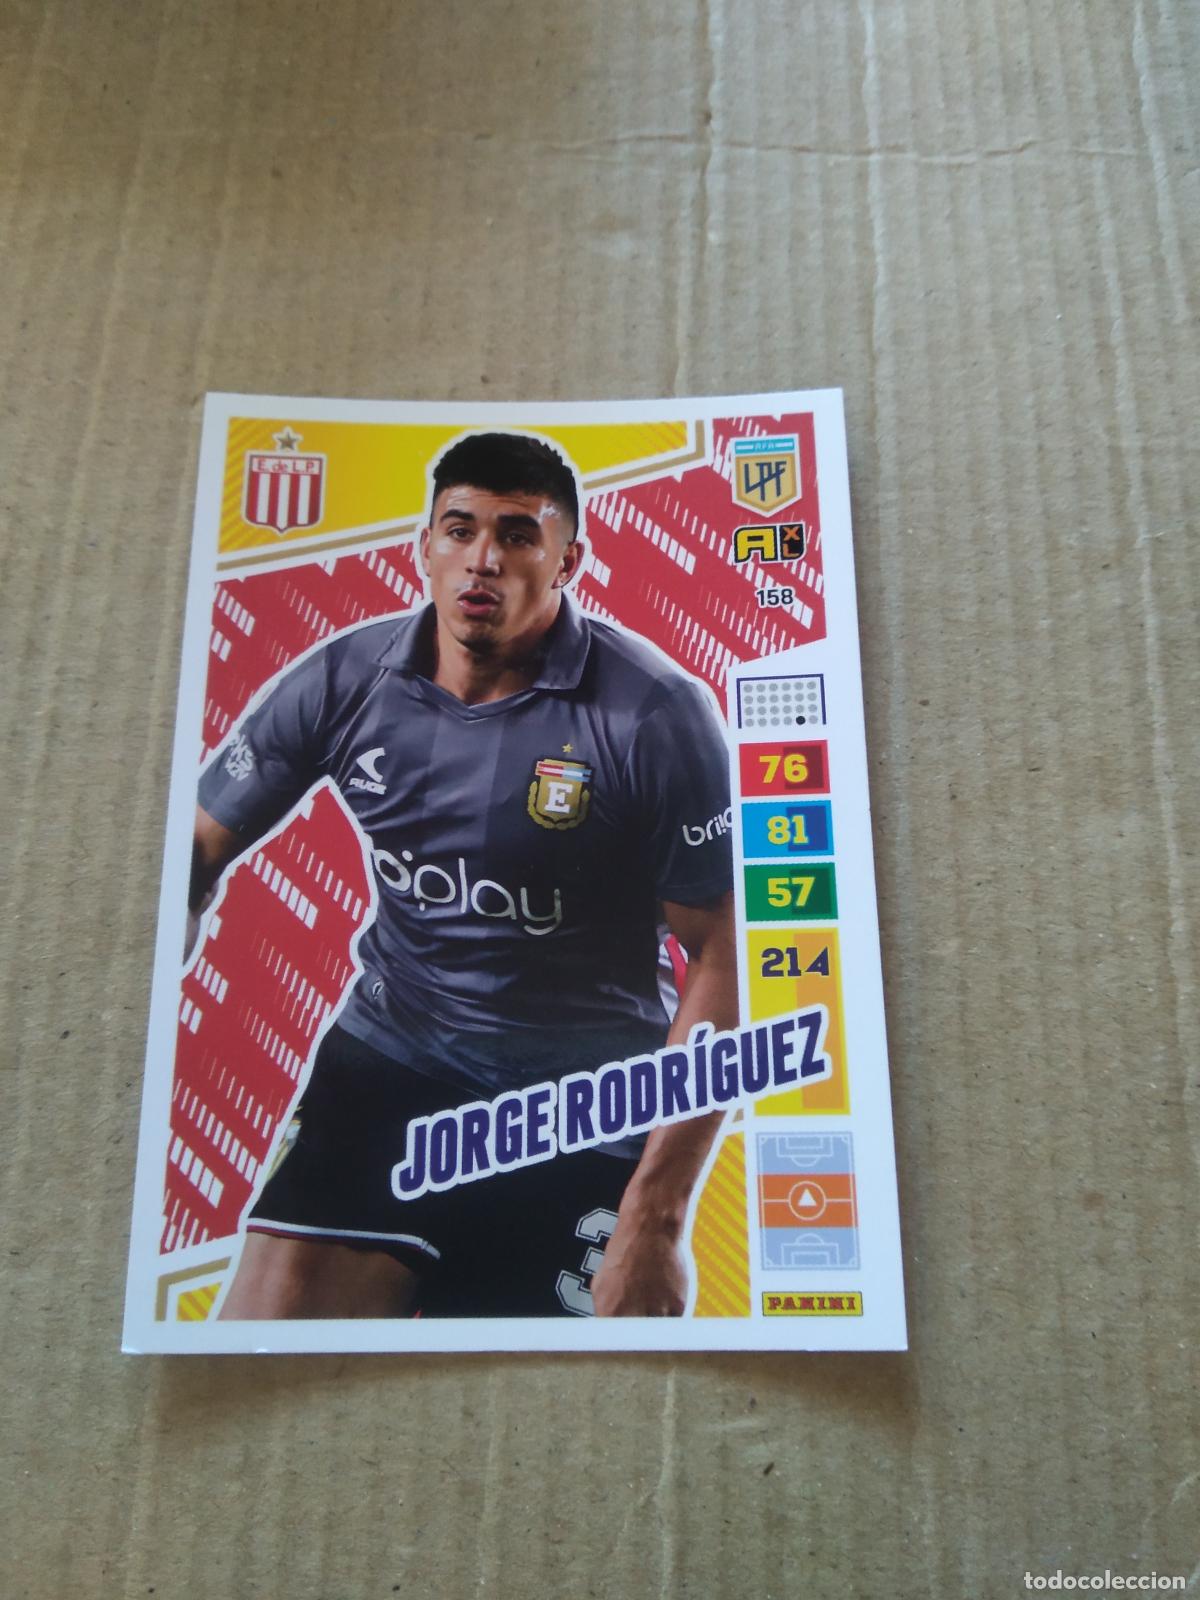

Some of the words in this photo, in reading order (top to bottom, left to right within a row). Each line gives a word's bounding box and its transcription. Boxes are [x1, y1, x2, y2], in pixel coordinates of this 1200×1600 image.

[756, 588, 794, 606] 158
[759, 754, 808, 784] 76
[544, 781, 574, 813] E
[767, 815, 809, 845] 81
[767, 876, 815, 908] 57
[761, 946, 830, 977] 214
[398, 1089, 552, 1194] JORGE
[565, 1011, 826, 1146] RODRÍGUEZ
[767, 1296, 856, 1311] PANINI
